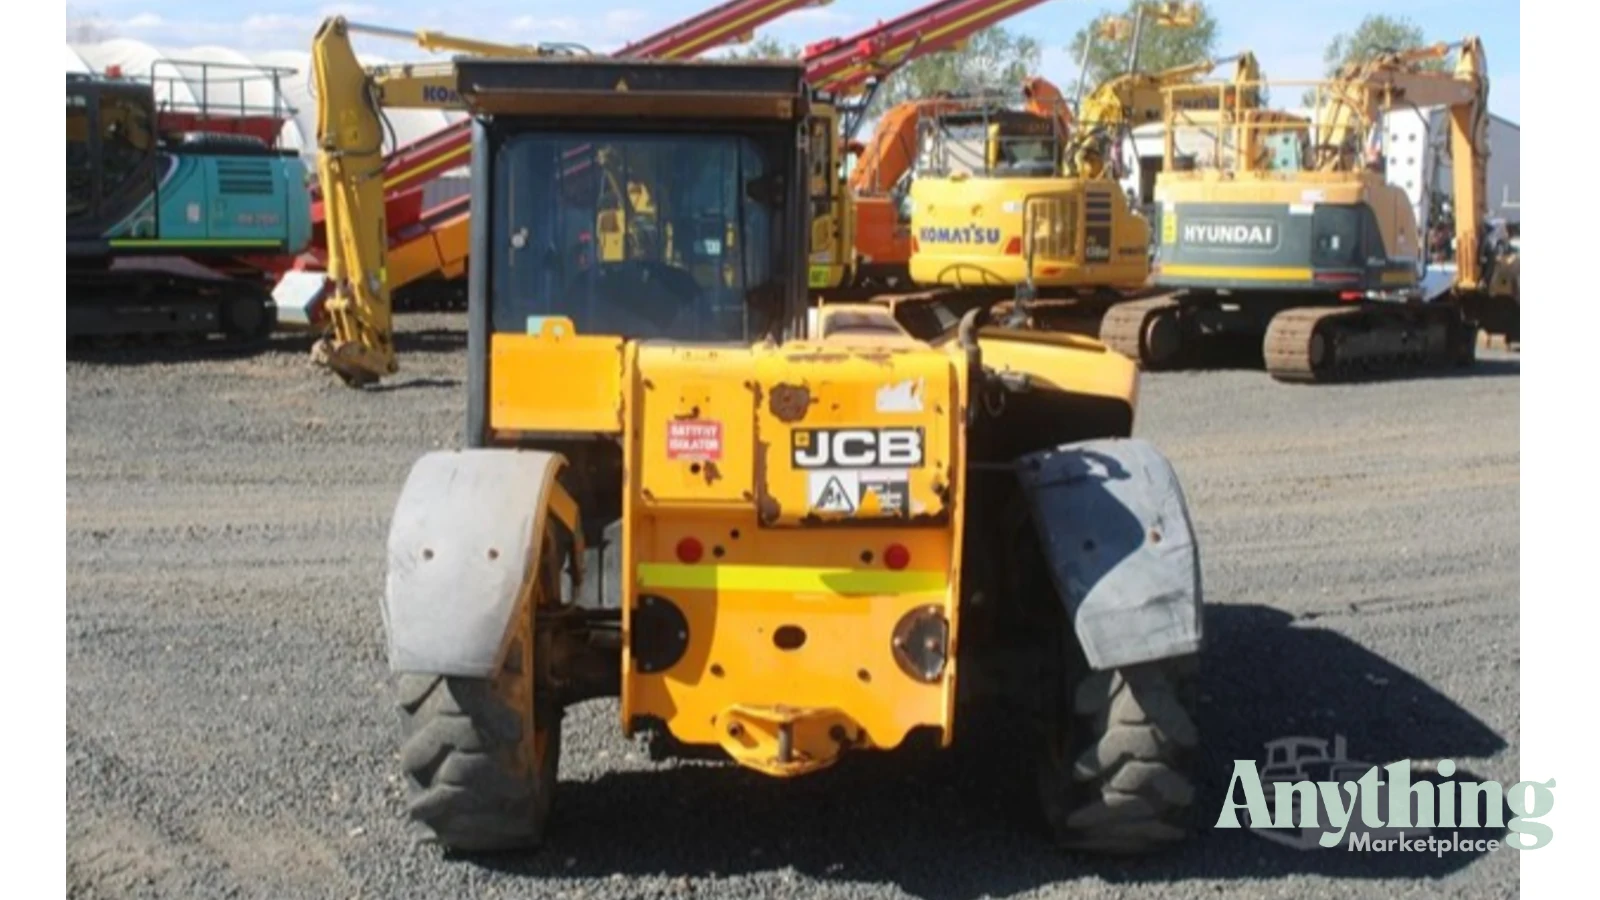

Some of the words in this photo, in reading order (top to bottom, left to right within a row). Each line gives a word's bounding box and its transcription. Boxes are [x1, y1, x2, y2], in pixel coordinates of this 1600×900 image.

[920, 227, 1000, 244] KOMATSU
[1184, 225, 1272, 243] HYUNDAI
[795, 430, 922, 466] JCB
